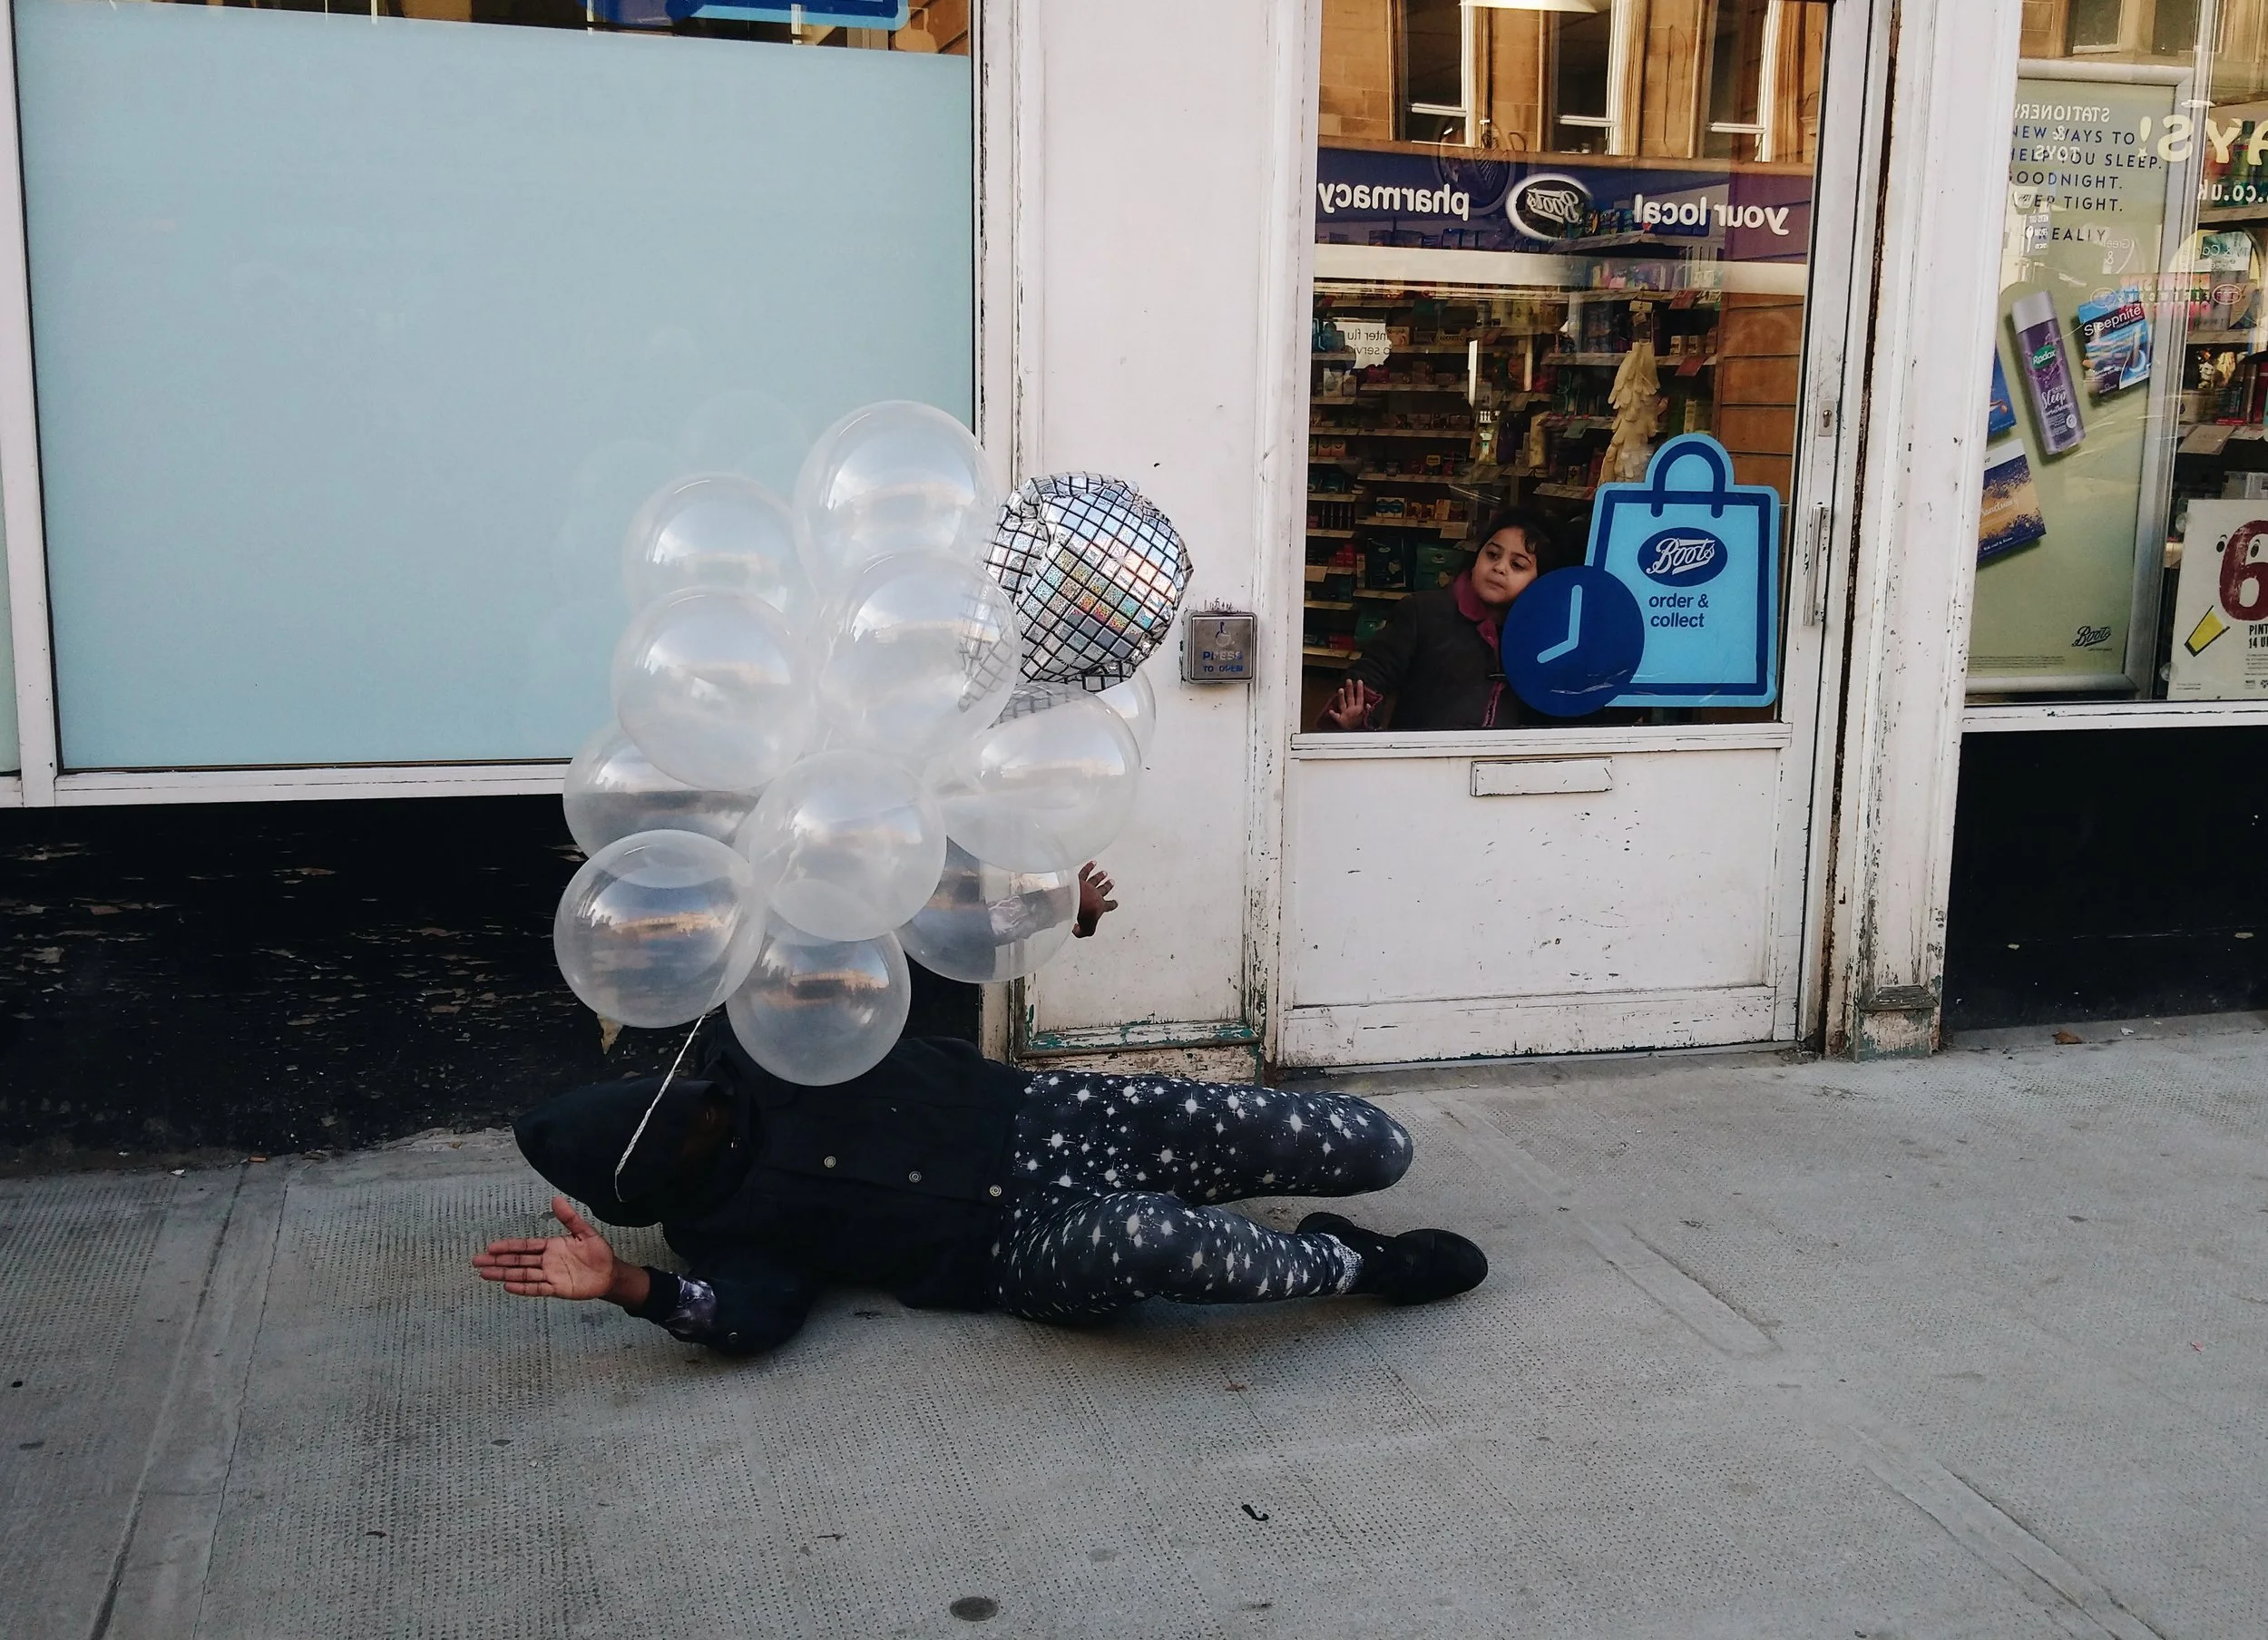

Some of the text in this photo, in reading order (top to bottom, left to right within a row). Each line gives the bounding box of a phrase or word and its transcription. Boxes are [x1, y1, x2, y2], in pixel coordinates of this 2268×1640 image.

[2112, 132, 2136, 145] TO
[2105, 153, 2163, 171] SLEEP.
[2009, 171, 2123, 190] OODNIGHT.
[2064, 195, 2123, 212] TIGHT.
[2083, 304, 2143, 337] Sleepnite
[2032, 349, 2057, 366] Radox
[1646, 537, 1716, 576] Boots
[1648, 592, 1709, 609] order &
[1650, 612, 1706, 629] collect
[2071, 625, 2112, 648] Boots
[2248, 637, 2258, 649] 14
